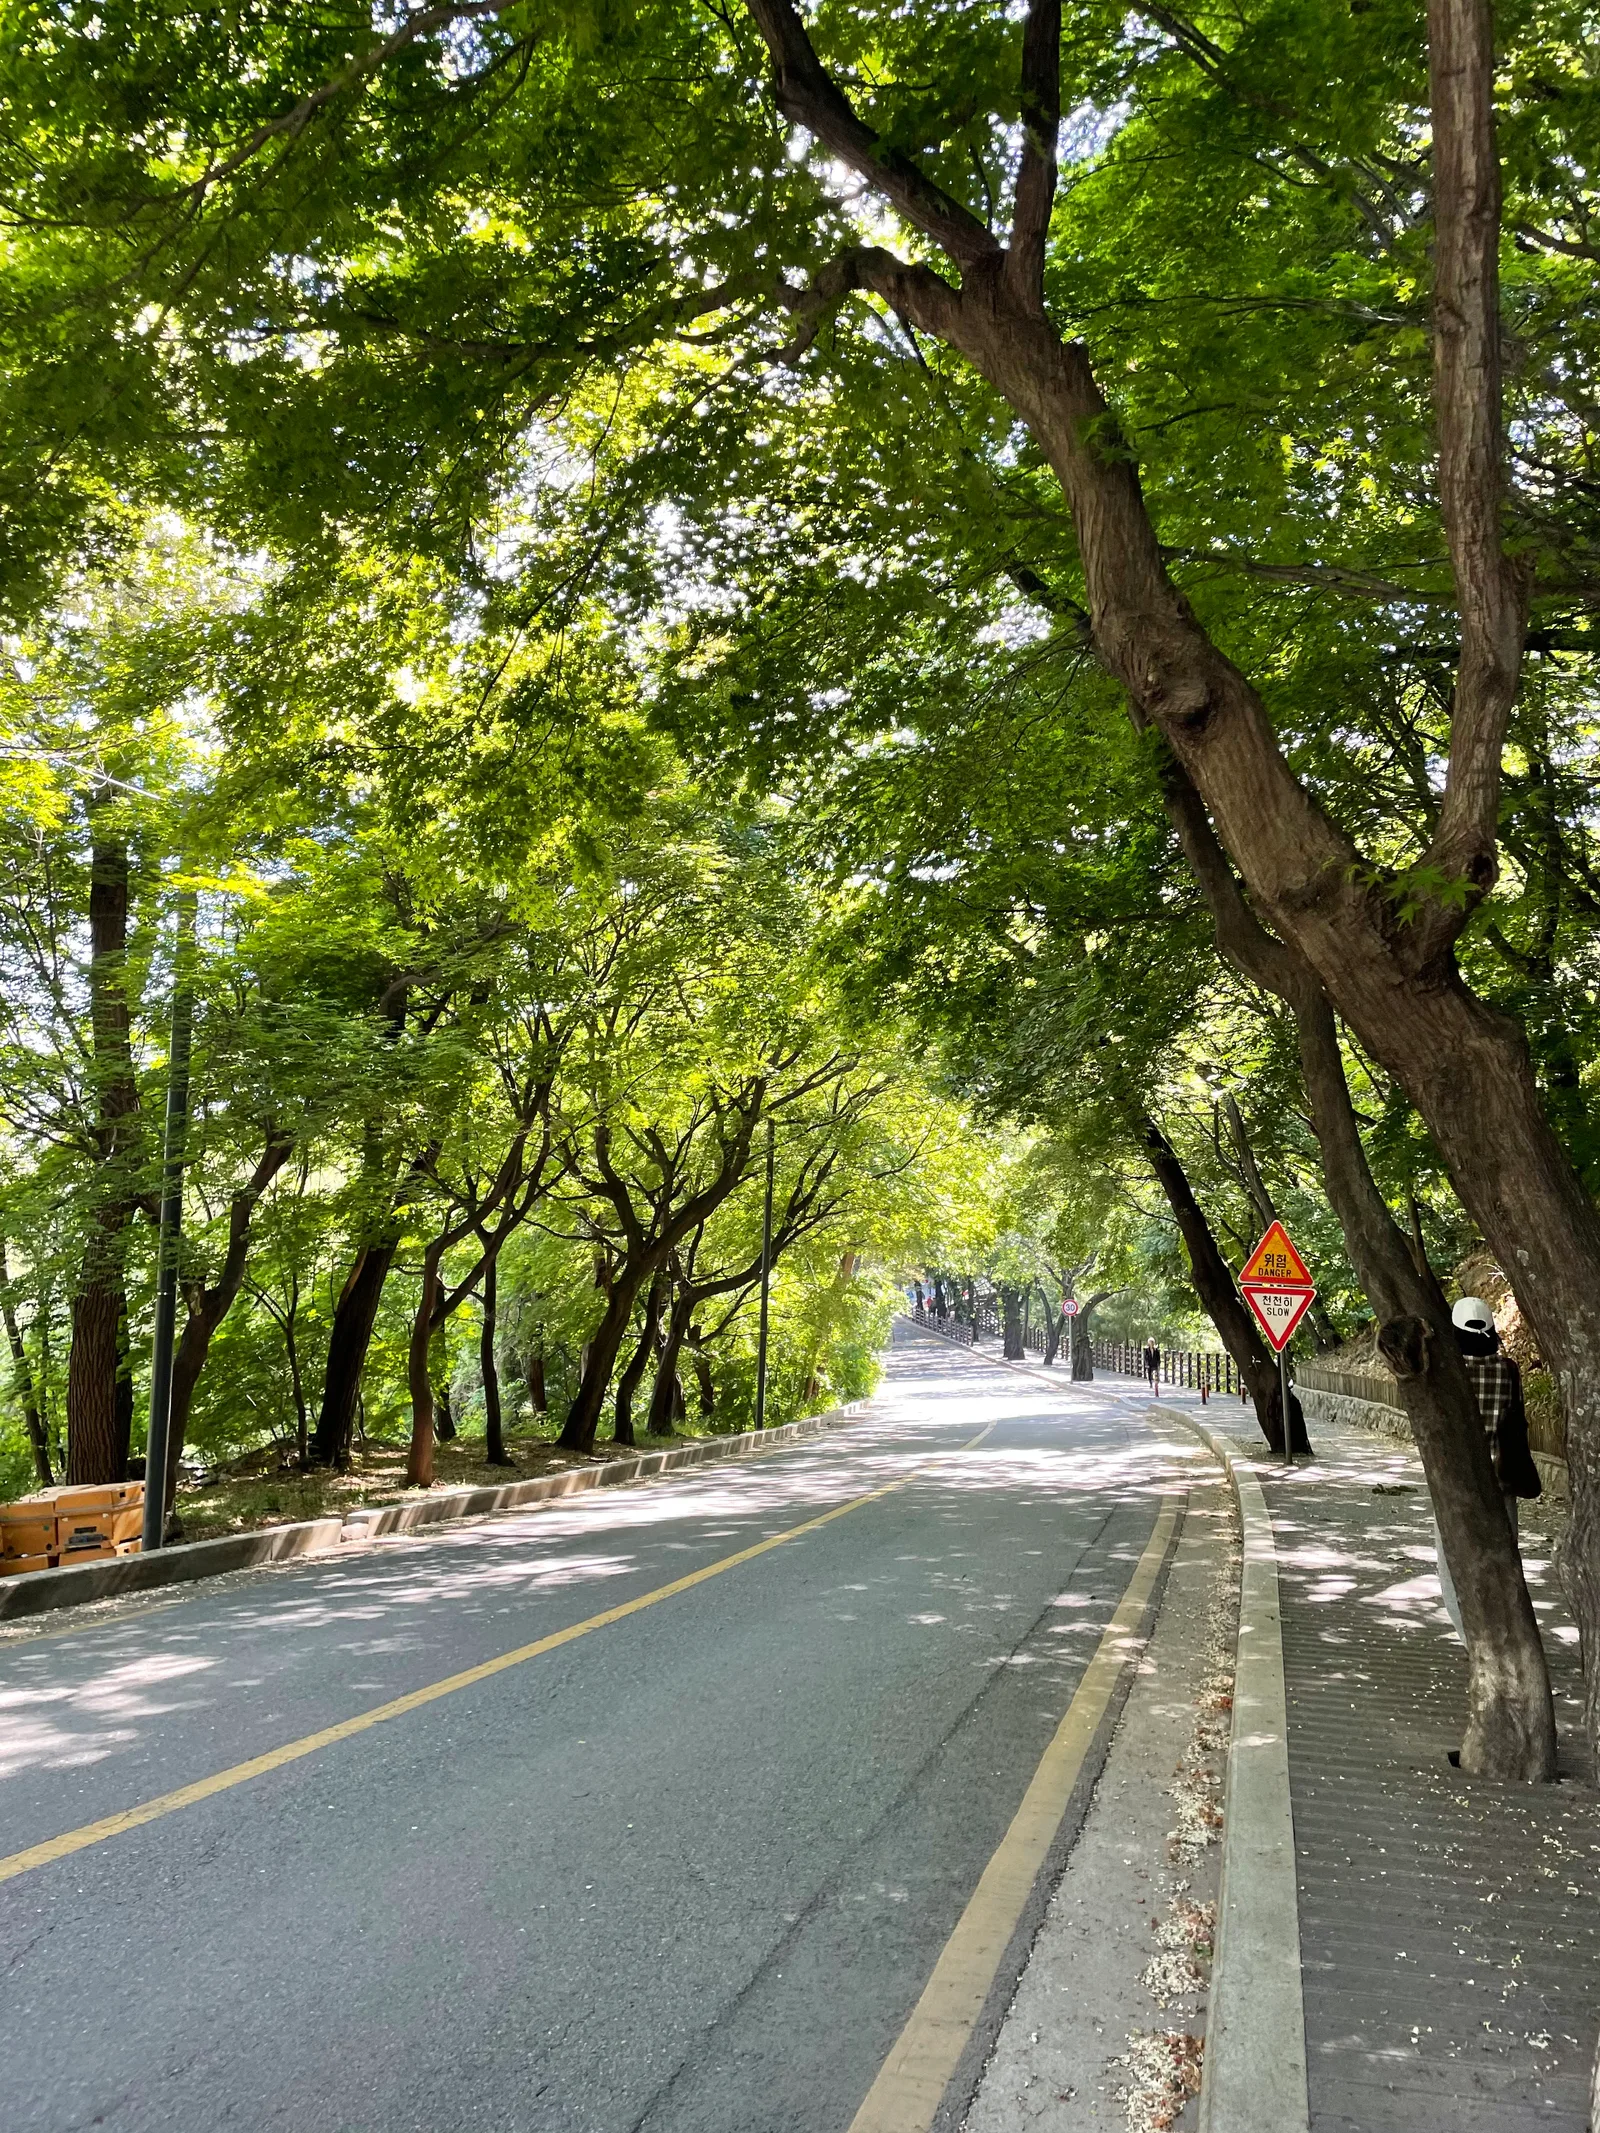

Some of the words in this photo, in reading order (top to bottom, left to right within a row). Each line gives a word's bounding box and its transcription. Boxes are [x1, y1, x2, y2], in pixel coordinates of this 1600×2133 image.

[1264, 1253, 1287, 1268] 위험
[1258, 1268, 1292, 1278] DANGER
[1262, 1295, 1293, 1307] 천천히
[1065, 1303, 1075, 1312] 30
[1266, 1307, 1290, 1317] SLOW
